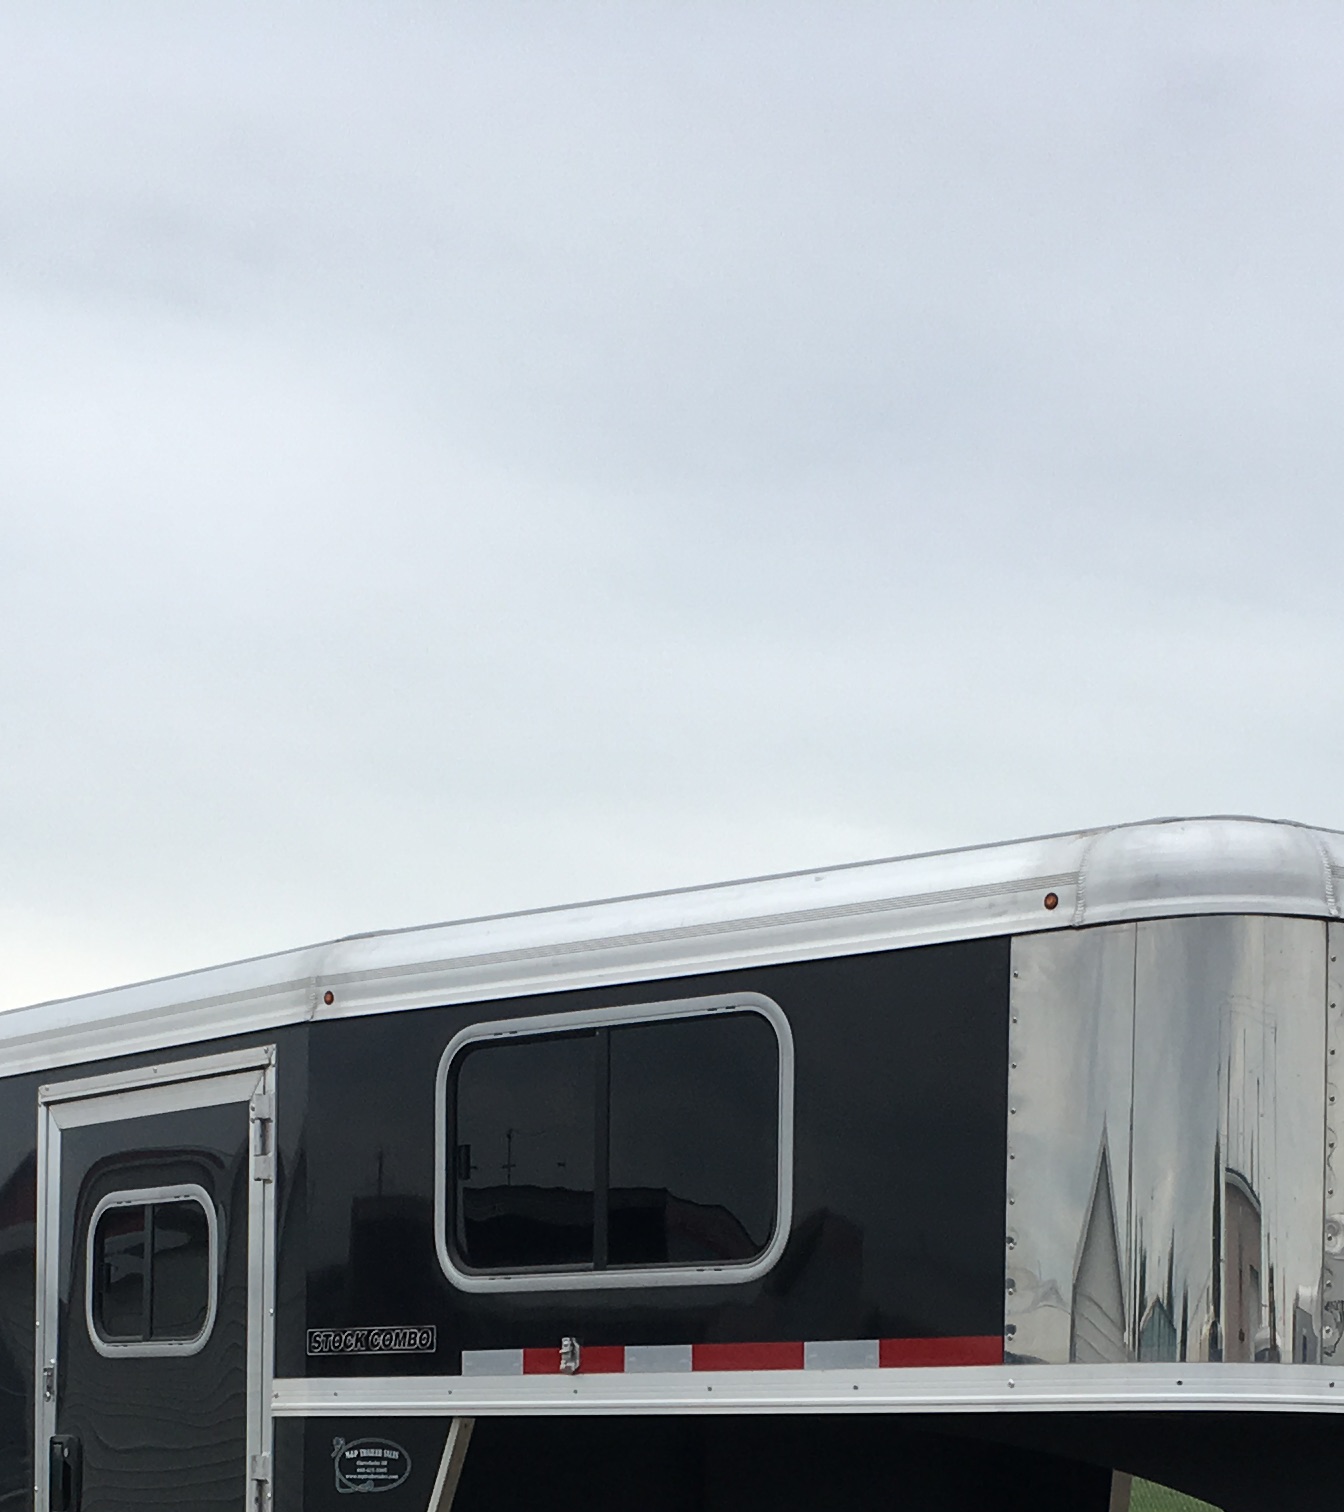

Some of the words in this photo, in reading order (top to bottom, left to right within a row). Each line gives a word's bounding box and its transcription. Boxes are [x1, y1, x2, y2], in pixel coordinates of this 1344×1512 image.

[311, 1331, 367, 1352] STOCK
[369, 1328, 432, 1350] COMBO
[360, 1449, 383, 1457] TRAILER
[384, 1450, 399, 1460] SALES
